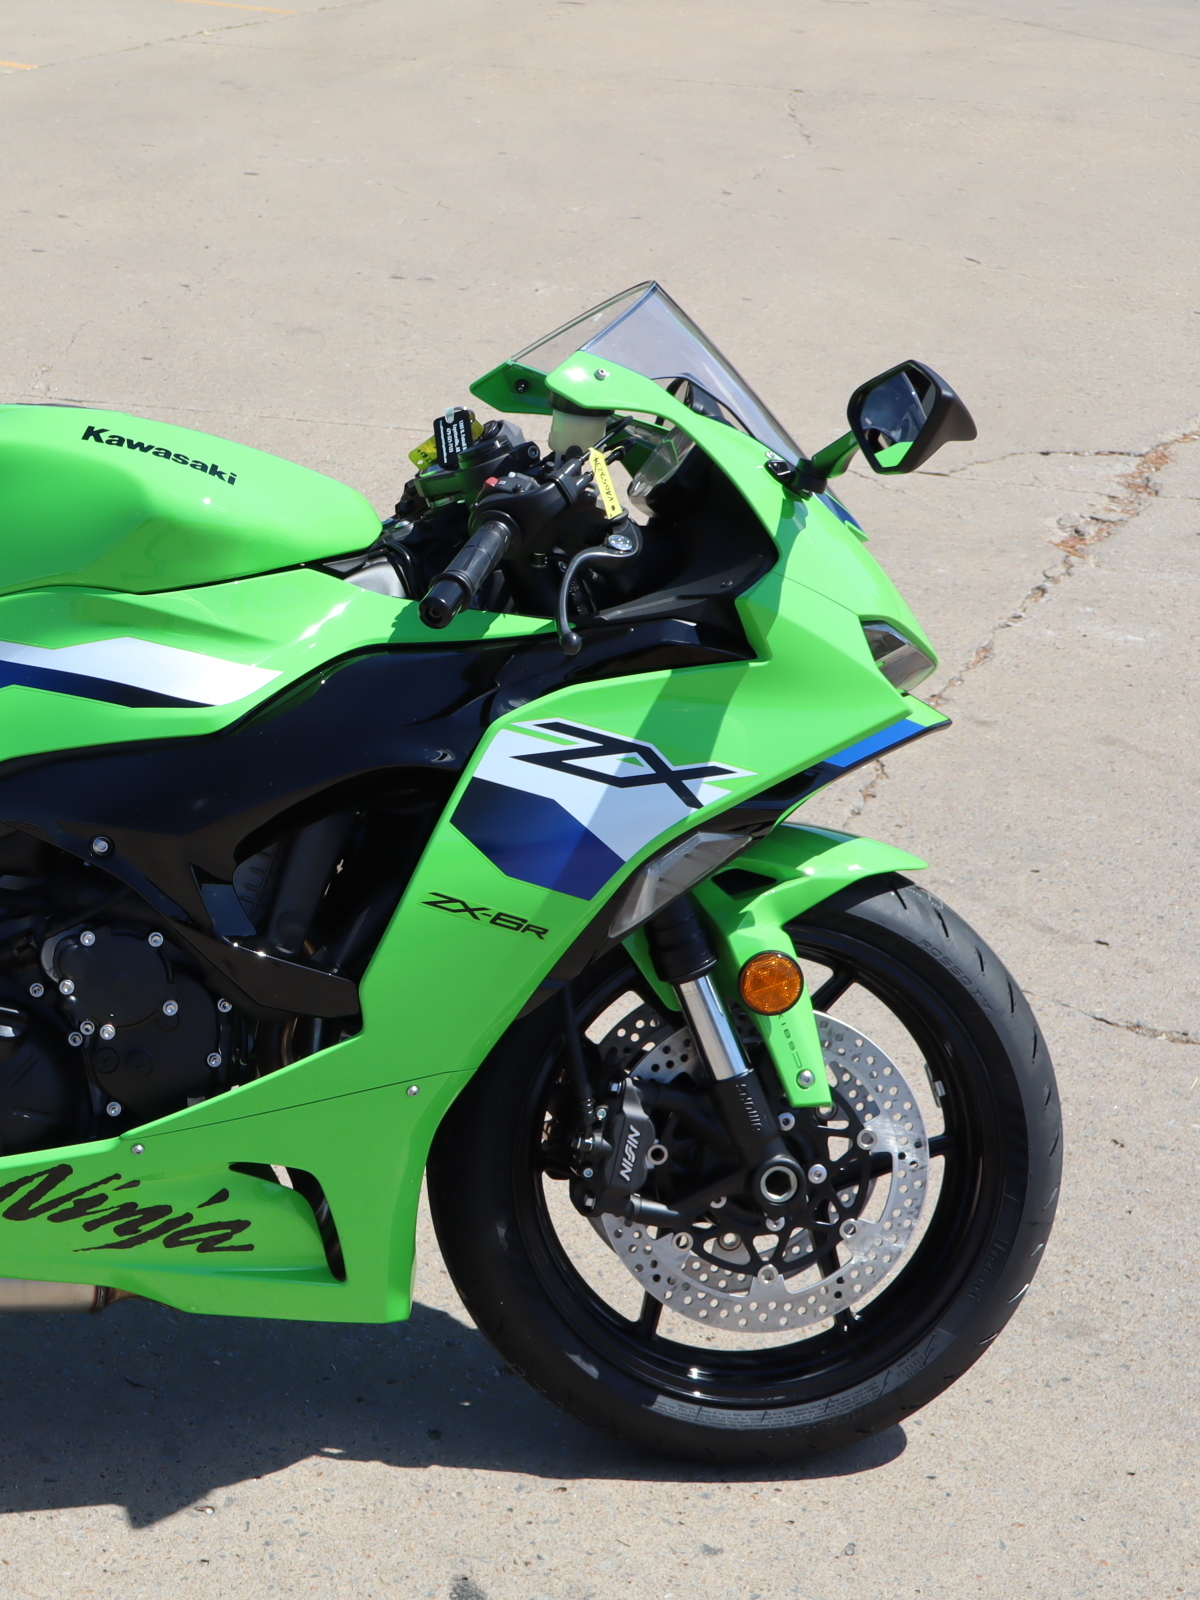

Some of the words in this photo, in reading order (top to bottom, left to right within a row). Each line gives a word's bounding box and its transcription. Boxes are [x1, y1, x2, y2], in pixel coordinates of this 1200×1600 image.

[81, 425, 238, 486] Kawasaki
[508, 721, 739, 810] ZX
[420, 892, 550, 940] ZX-6R
[919, 939, 973, 988] ROSSO
[620, 1124, 641, 1182] NISSIN
